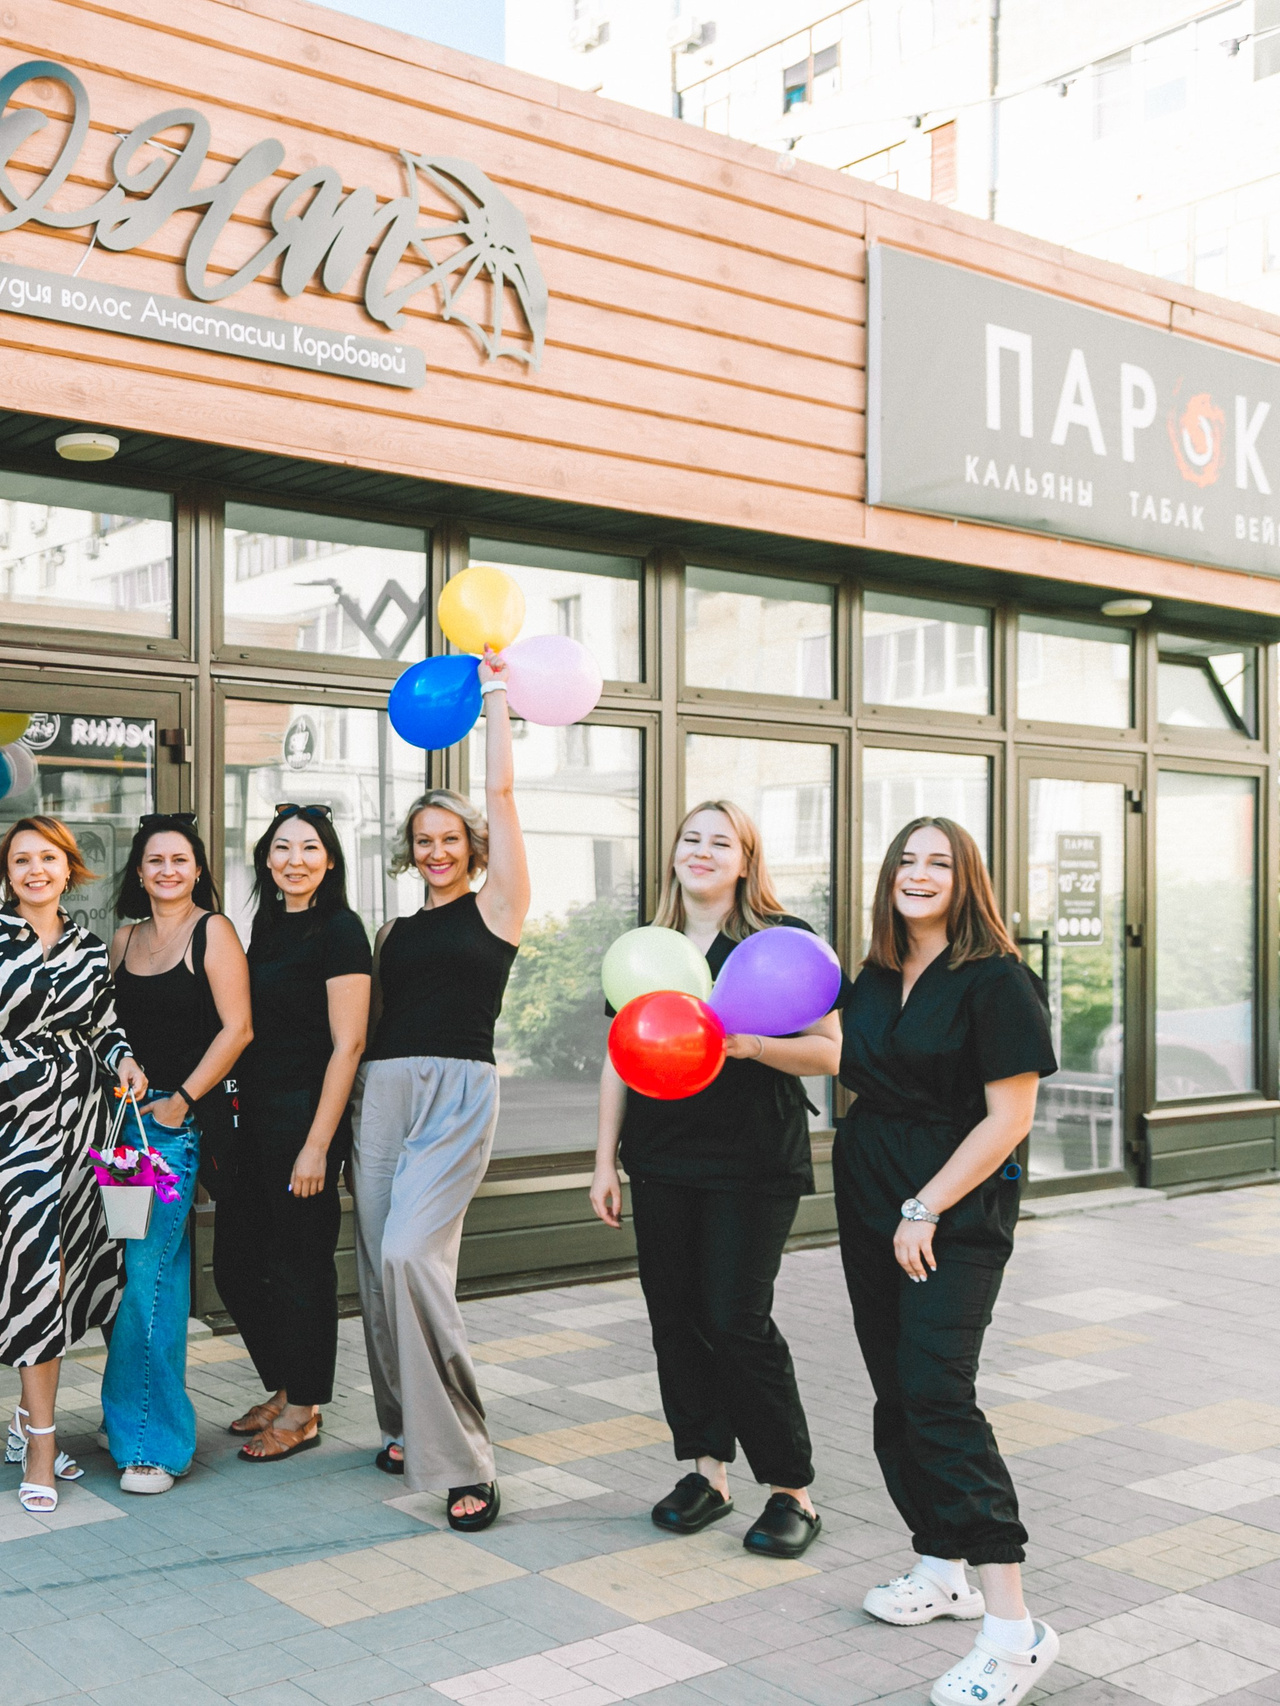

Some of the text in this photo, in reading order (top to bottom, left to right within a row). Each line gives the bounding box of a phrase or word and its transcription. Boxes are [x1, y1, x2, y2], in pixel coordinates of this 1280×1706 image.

[61, 286, 131, 320] волос
[140, 296, 285, 351] Анастасии
[293, 325, 406, 375] Коробовой
[985, 322, 1273, 495] ПАРОК
[965, 454, 1280, 548] КАЛЬЯНЫ ТАБАК ВЕЙ
